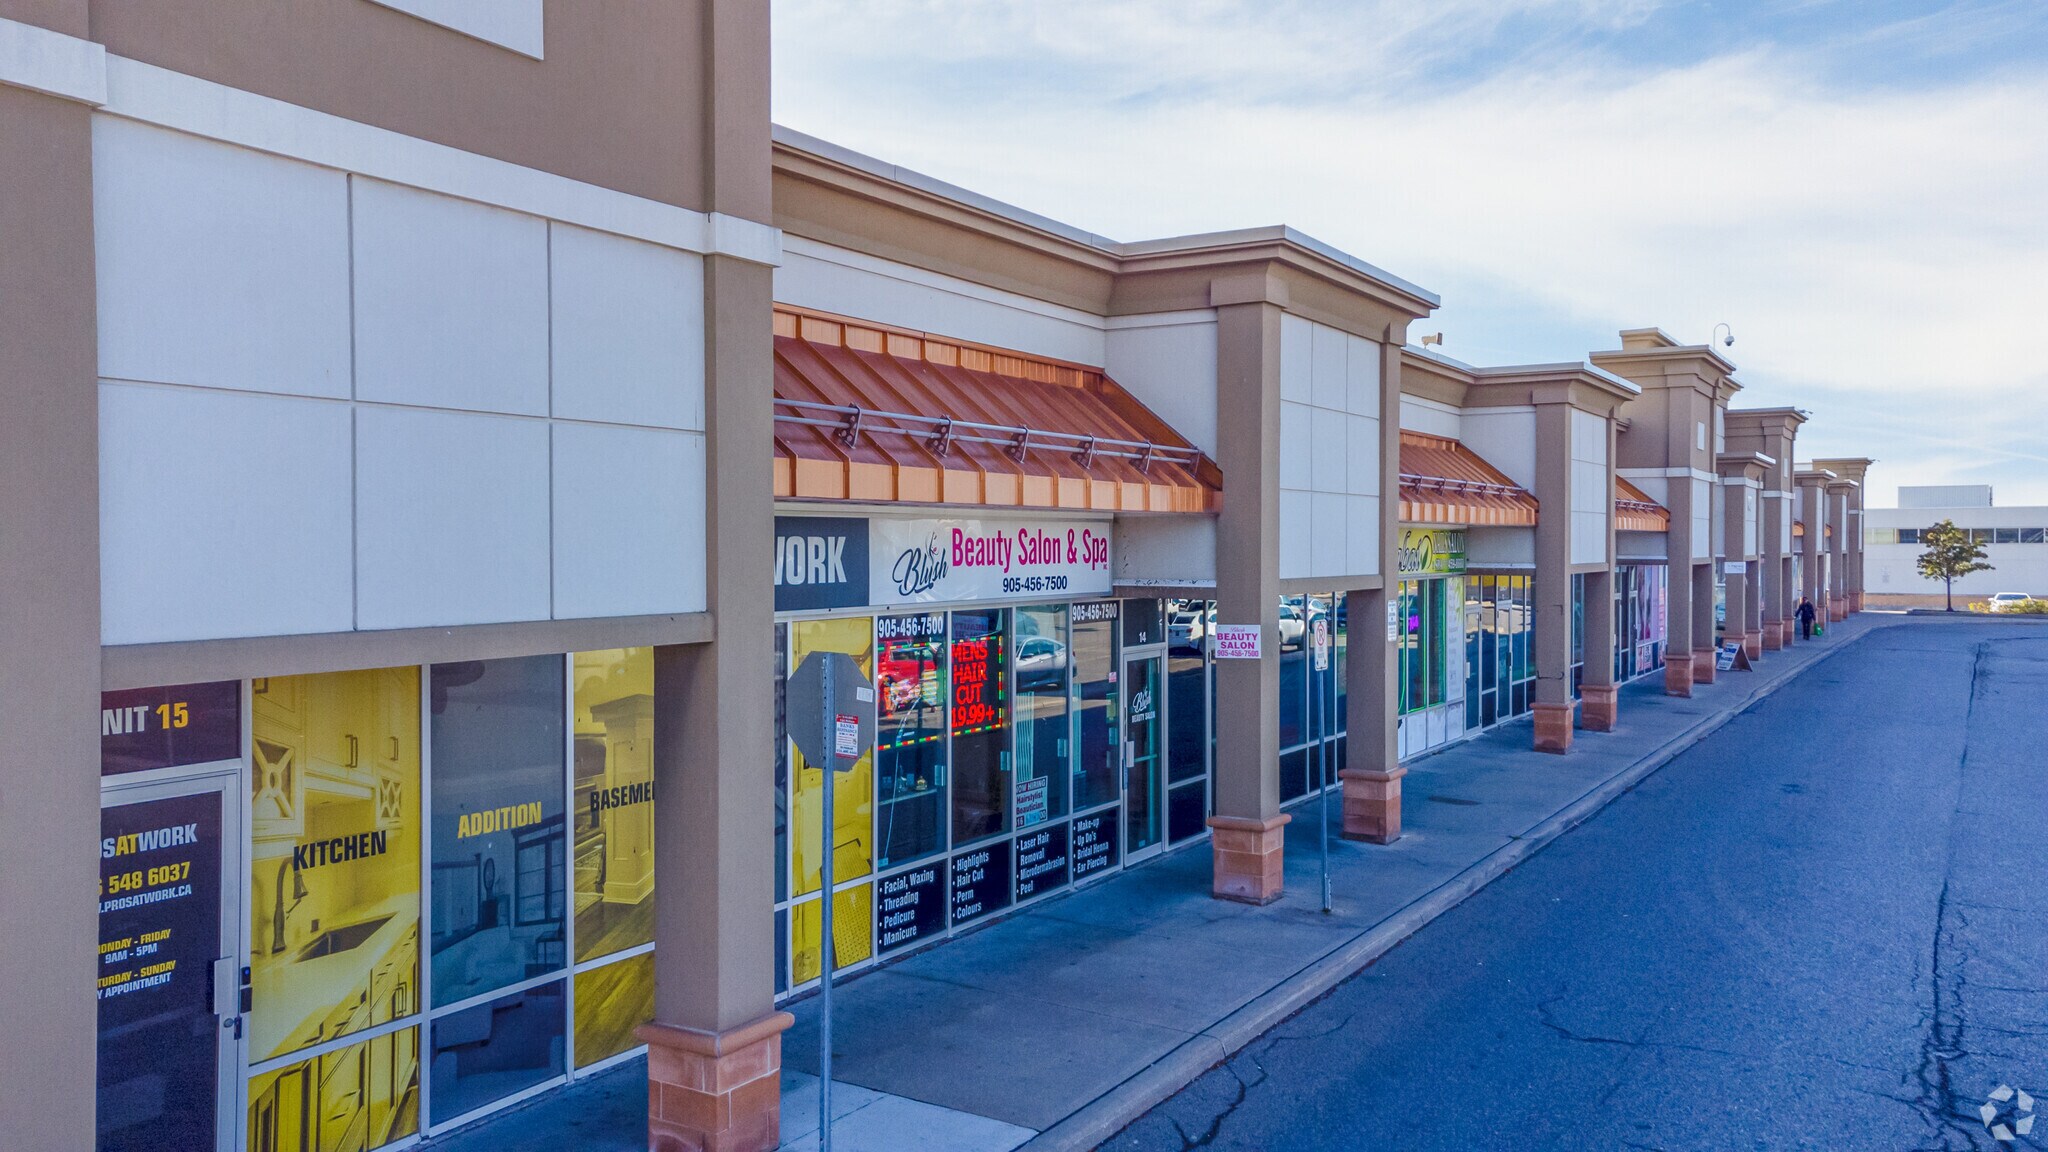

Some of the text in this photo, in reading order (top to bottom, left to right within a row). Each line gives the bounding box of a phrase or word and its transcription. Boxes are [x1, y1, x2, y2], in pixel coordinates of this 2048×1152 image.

[952, 528, 1108, 573] Beauty Salon & Spa
[892, 547, 949, 596] Blush
[1003, 575, 1068, 592] 905-456-7500
[1072, 603, 1118, 621] 905-456-7500
[878, 616, 944, 638] 905-456-7500
[1139, 631, 1147, 643] 14
[1217, 633, 1258, 641] BEAUTY
[951, 642, 989, 663] MENS
[1220, 641, 1255, 650] SALON
[953, 662, 988, 685] HAIR
[956, 682, 984, 705] CUT
[102, 702, 189, 736] NIT 15
[590, 780, 655, 812] BASEME
[457, 801, 542, 839] ADDITION
[1077, 818, 1100, 832] Make-up
[101, 823, 198, 859] SATWORK
[293, 829, 387, 872] KITCHEN
[1020, 832, 1050, 851] Laser Hair
[957, 852, 990, 872] Highlights
[1020, 847, 1045, 866] Removal
[108, 871, 143, 894] 548
[147, 861, 190, 886] 6037
[957, 868, 984, 888] Hair Cut
[1077, 862, 1086, 873] Ear
[884, 869, 934, 895] Facial, Waxing
[1020, 880, 1034, 895] Peel
[99, 884, 192, 914] .PROSATWORK.CA
[884, 891, 919, 911] Threading
[957, 889, 974, 904] Perm
[884, 909, 915, 929] Pedicure
[956, 902, 982, 919] Colours
[140, 928, 172, 945] FRIDAY
[883, 925, 917, 946] Manicure
[105, 949, 128, 964] 9AM
[136, 943, 158, 957] 5PM
[97, 970, 132, 988] TURDAY
[140, 959, 176, 977] SUNDAY
[104, 972, 172, 998] APPOINTMENT
